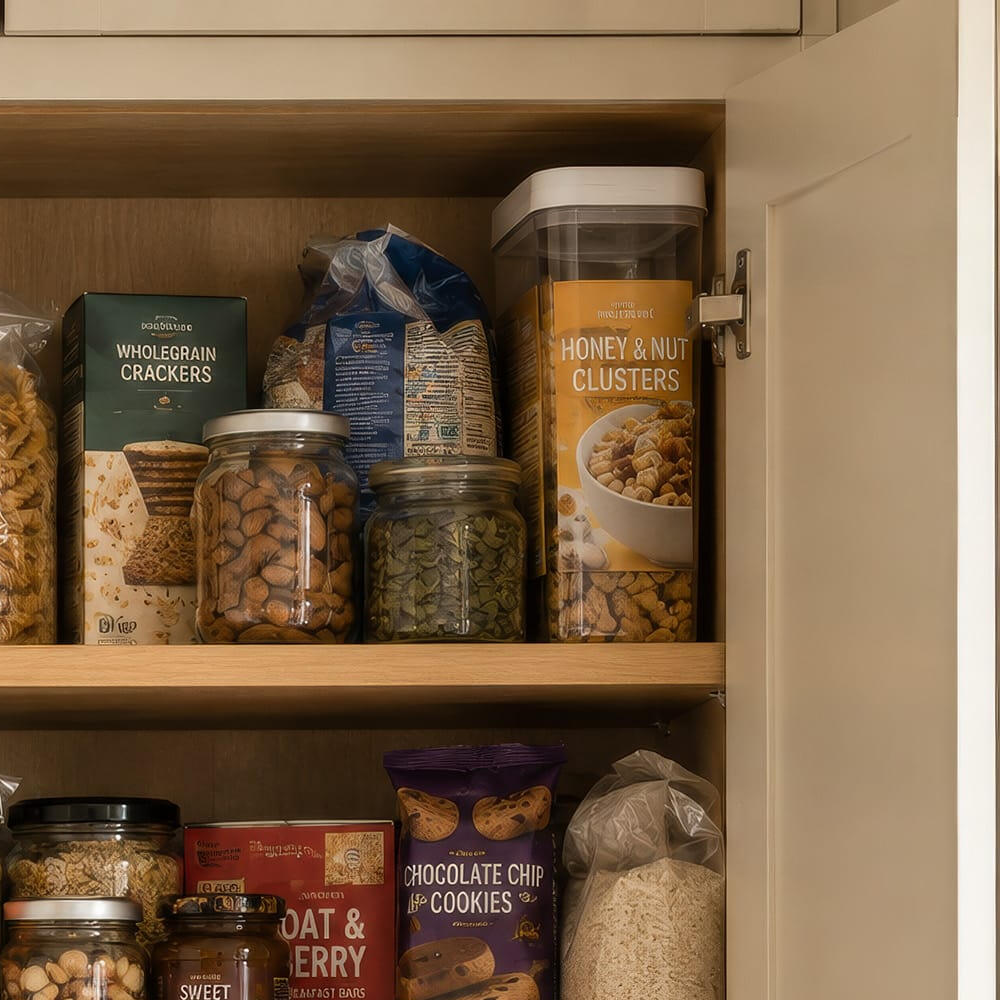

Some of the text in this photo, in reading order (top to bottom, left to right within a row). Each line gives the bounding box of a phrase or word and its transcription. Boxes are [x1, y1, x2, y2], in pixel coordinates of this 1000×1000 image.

[116, 343, 217, 362] WHOLEGRAIN
[561, 336, 689, 361] HONEY & NUT
[121, 363, 212, 383] CRACKERS
[572, 367, 680, 392] CLUSTERS
[404, 863, 544, 888] CHOCOLATE CHIP
[430, 890, 512, 914] COOKIES
[281, 908, 365, 940] OAT &
[289, 945, 367, 978] ERRY
[180, 984, 231, 1000] SWEET
